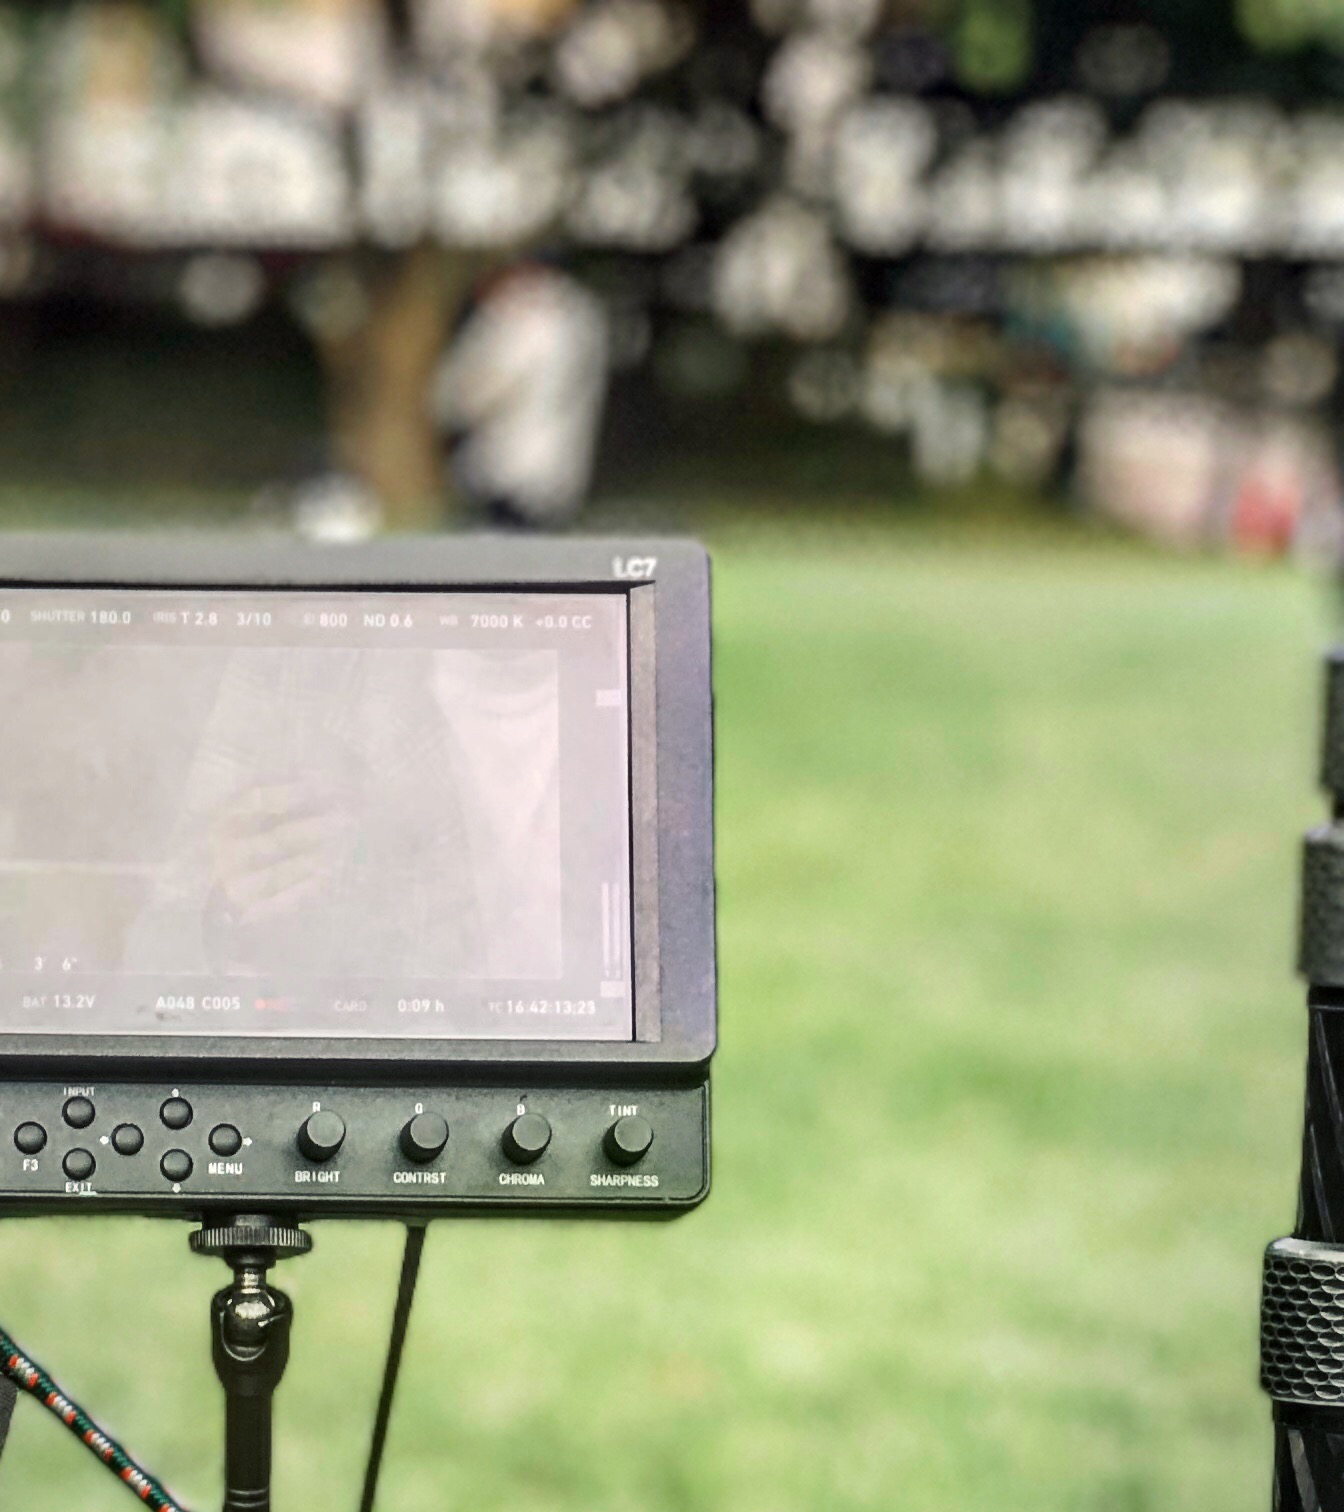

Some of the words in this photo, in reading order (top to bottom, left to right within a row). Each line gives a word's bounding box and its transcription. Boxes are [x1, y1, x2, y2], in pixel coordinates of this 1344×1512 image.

[612, 555, 657, 578] LC7
[30, 610, 85, 623] SHUTTER
[90, 611, 132, 625] 180.0
[195, 611, 218, 626] 2.8
[236, 611, 272, 626] 3/10
[319, 613, 348, 628] 800
[364, 614, 386, 628] ND
[389, 614, 413, 629] 0.6
[471, 614, 509, 629] 7000
[513, 615, 524, 629] K
[53, 994, 97, 1009] 13.2V
[201, 995, 241, 1011] C005
[609, 1104, 639, 1116] TINT
[207, 1161, 244, 1175] MENU
[294, 1170, 341, 1183] BRIGHT
[392, 1171, 447, 1184] CONTRST
[498, 1173, 546, 1187] CHROMA
[589, 1174, 660, 1188] SHARPNESS
[64, 1181, 93, 1193] EXIT
